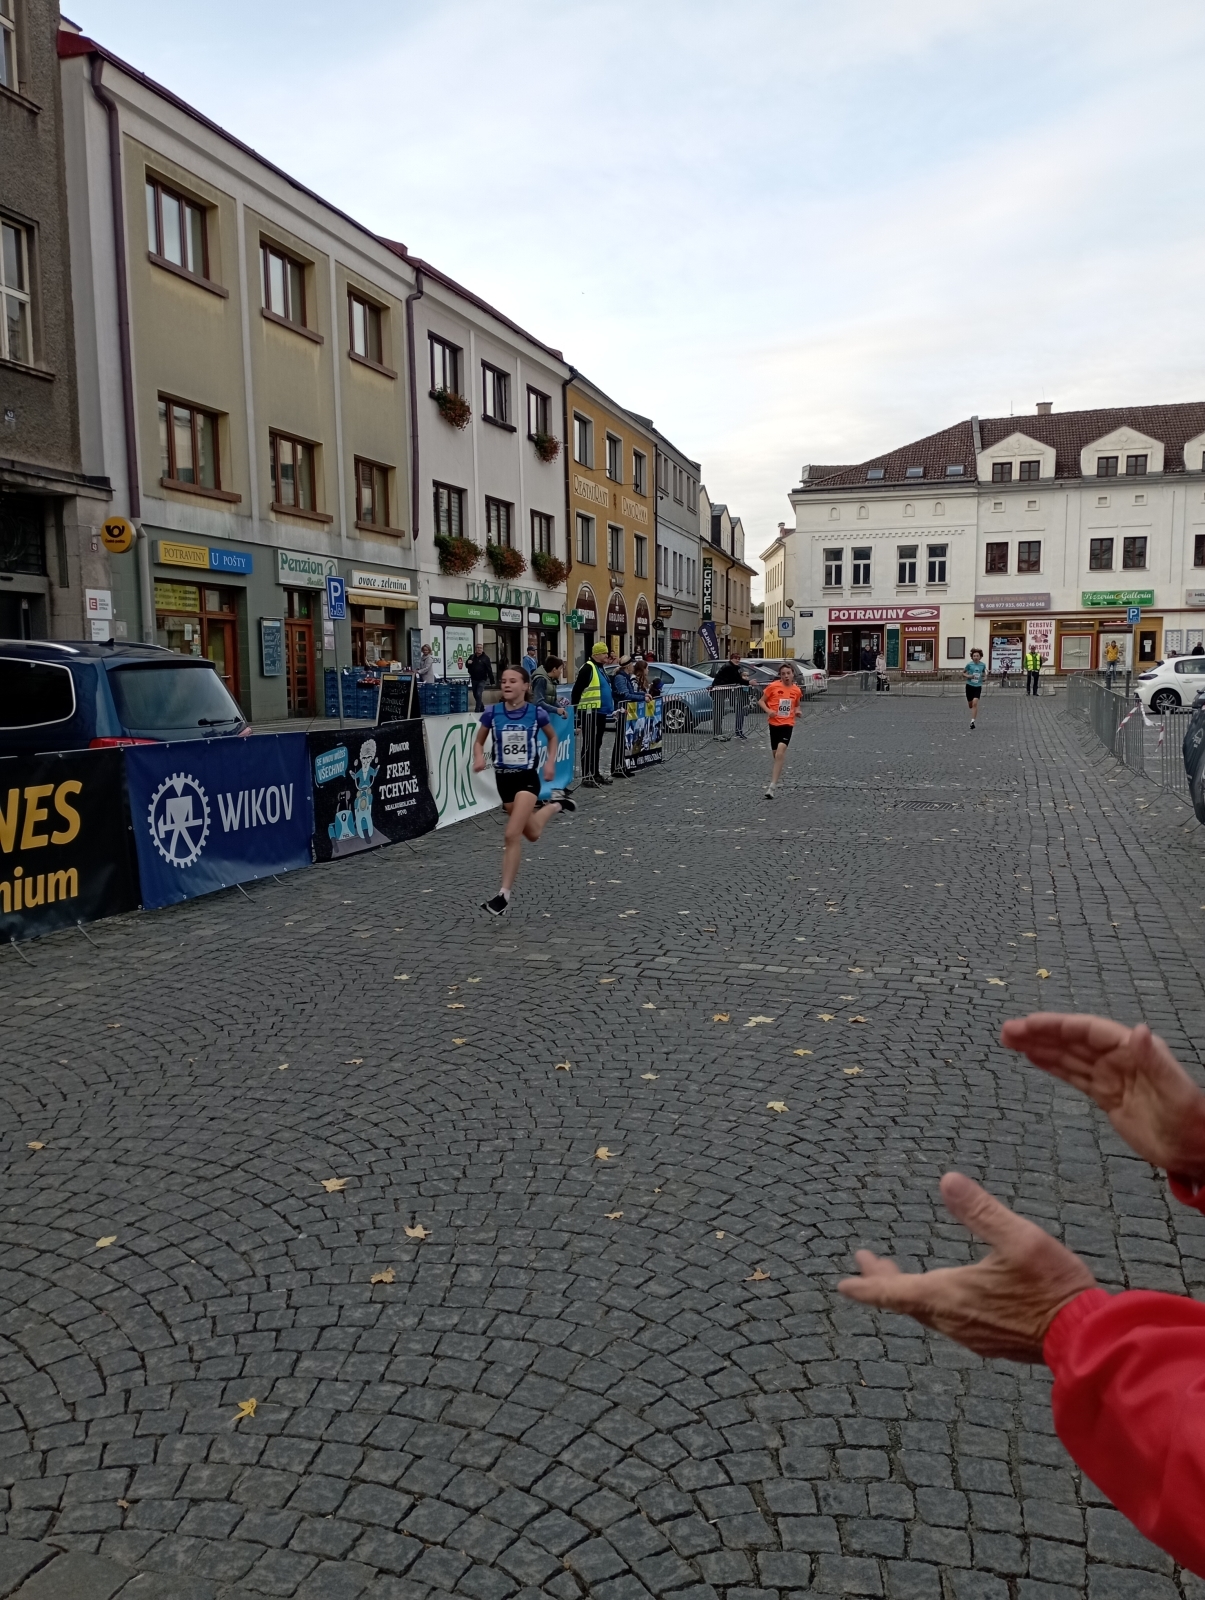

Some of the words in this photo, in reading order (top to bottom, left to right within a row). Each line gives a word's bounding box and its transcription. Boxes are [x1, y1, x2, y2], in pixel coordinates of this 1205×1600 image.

[164, 548, 205, 562] POTRAVINY
[211, 553, 218, 566] U
[223, 556, 246, 568] POŠTY
[280, 552, 324, 576] Penzion
[358, 576, 376, 586] ovoce
[381, 580, 407, 590] zelenina
[330, 582, 340, 605] P
[467, 580, 541, 608] LÉKÁRNA
[1083, 592, 1114, 600] Pizzeria
[831, 608, 905, 620] POTRAVINY
[1130, 609, 1137, 619] P
[503, 744, 527, 755] 684
[318, 761, 345, 780] VŠECHNO!
[386, 761, 410, 779] FREE
[379, 775, 419, 800] TCHYNĚ
[217, 783, 293, 832] WIKOV
[0, 866, 78, 913] nium
